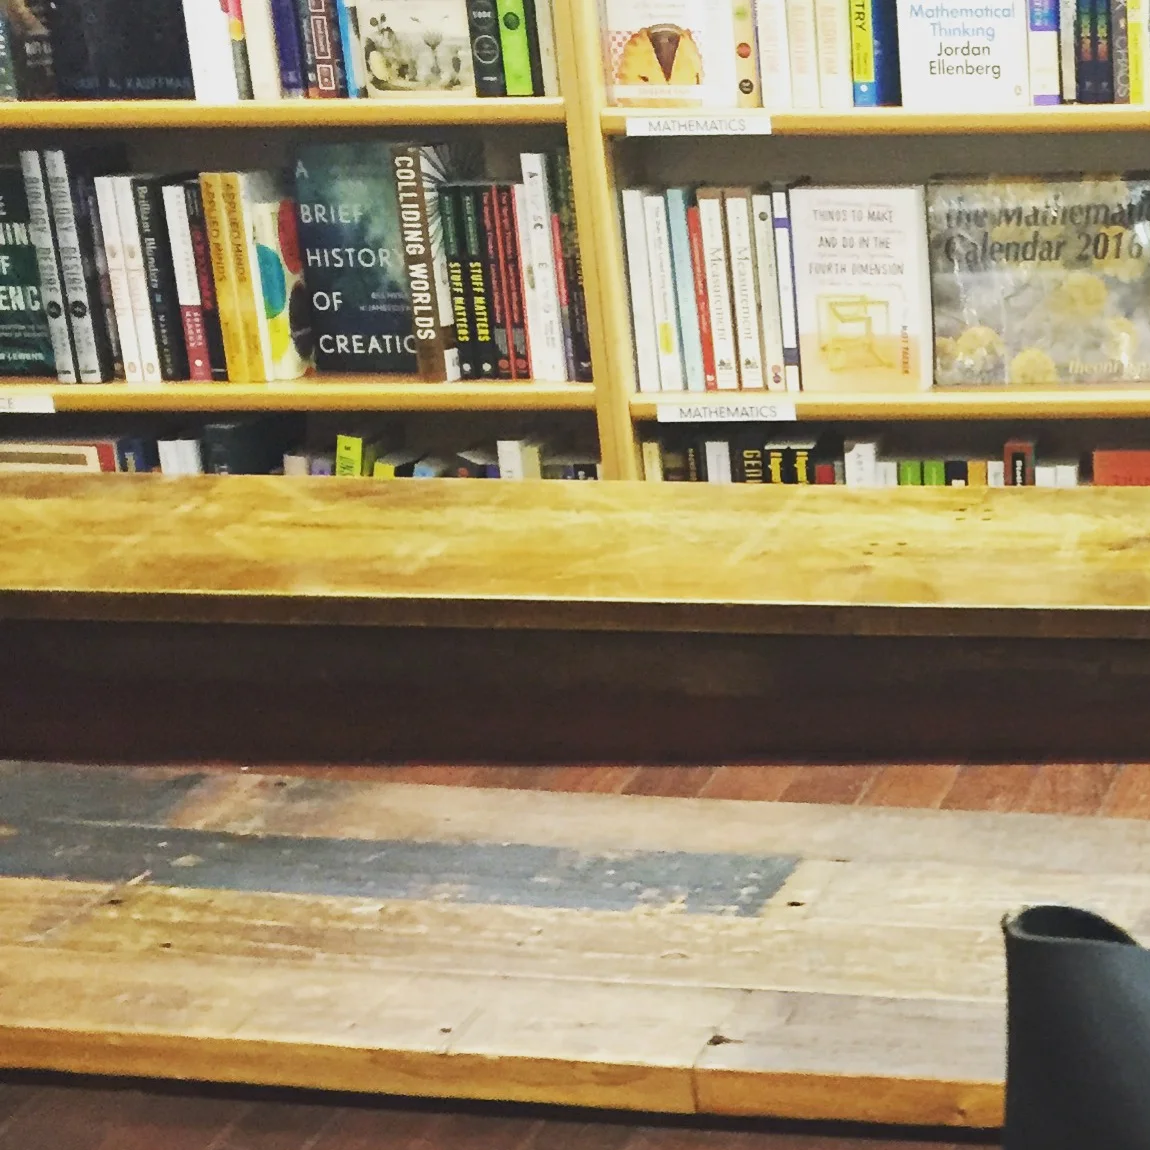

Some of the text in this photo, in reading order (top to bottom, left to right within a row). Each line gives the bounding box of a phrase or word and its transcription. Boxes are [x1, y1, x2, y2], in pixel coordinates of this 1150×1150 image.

[909, 4, 1015, 18] Mathematical
[930, 22, 996, 41] Thinking
[937, 41, 991, 57] Jordan
[929, 58, 1001, 79] Ellenberg
[648, 118, 746, 133] MATHEMATICS
[295, 159, 309, 179] A
[300, 204, 363, 224] BRIEF
[813, 209, 893, 223] THINGS TO MAKE
[394, 156, 436, 341] COLLIDING WORLDS
[817, 236, 891, 249] AND DO IN THE
[944, 231, 1144, 267] Calendar 2016
[145, 238, 159, 290] Blunders
[808, 262, 905, 276] FOURTH DIMENSION
[449, 261, 464, 294] STUFF
[312, 291, 343, 312] OF
[469, 261, 491, 343] STUFF MATTERS
[710, 247, 727, 341] Measurement
[736, 247, 752, 340] Measurement
[453, 296, 470, 343] MATTERS
[679, 405, 778, 419] MATHEMATICS
